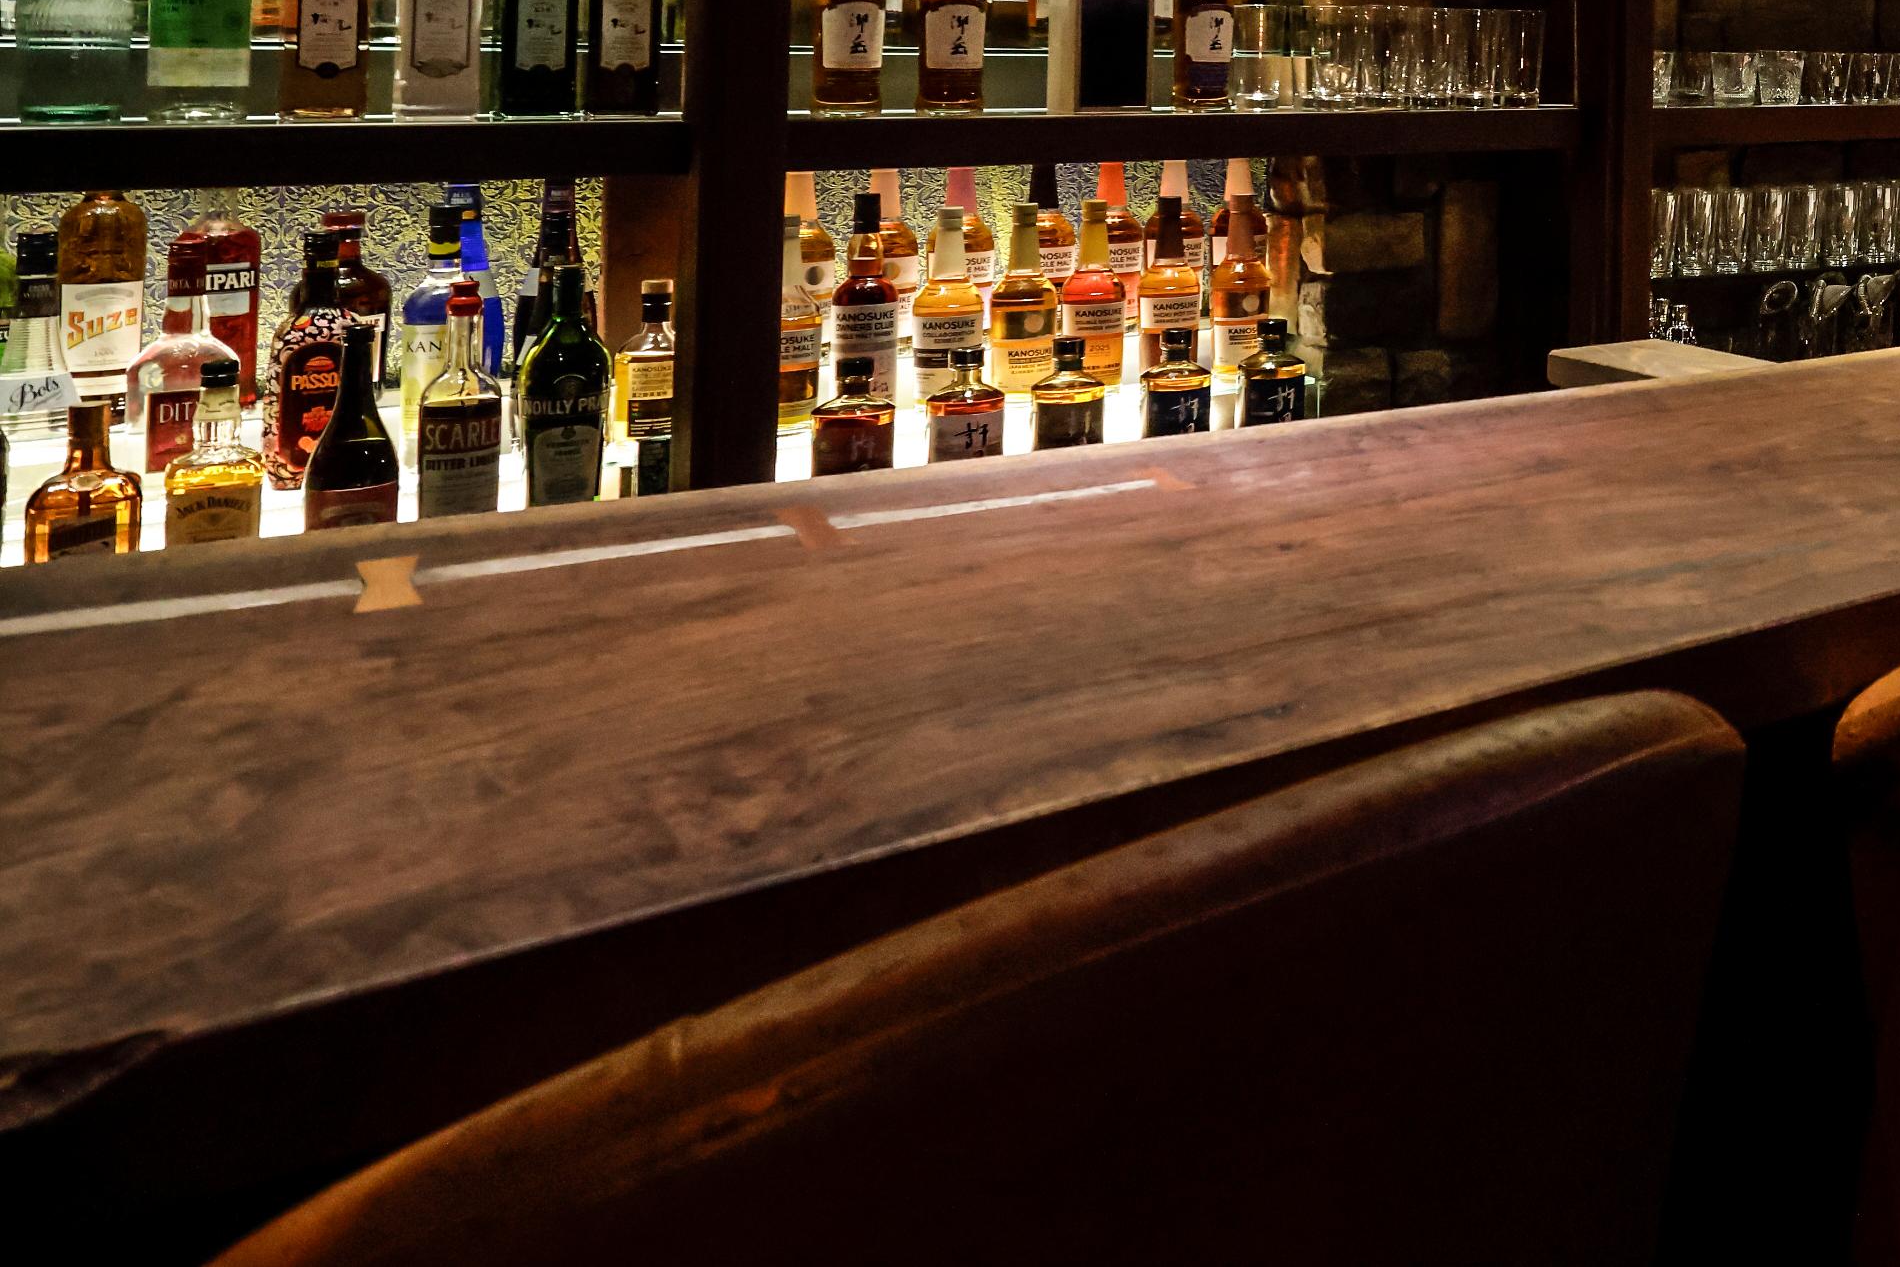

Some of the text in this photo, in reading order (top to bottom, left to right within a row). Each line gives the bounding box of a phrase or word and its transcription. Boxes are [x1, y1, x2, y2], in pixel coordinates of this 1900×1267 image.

[1074, 307, 1123, 318] KANOSUKE
[1152, 301, 1198, 311] KANOSUKE
[836, 309, 896, 323] KANOSUKE
[66, 307, 139, 350] Suze
[921, 319, 976, 331] KANOSUKE
[1228, 327, 1257, 335] KANOS
[8, 377, 60, 414] Bols
[159, 401, 197, 424] DIT
[524, 397, 575, 417] NOILLY
